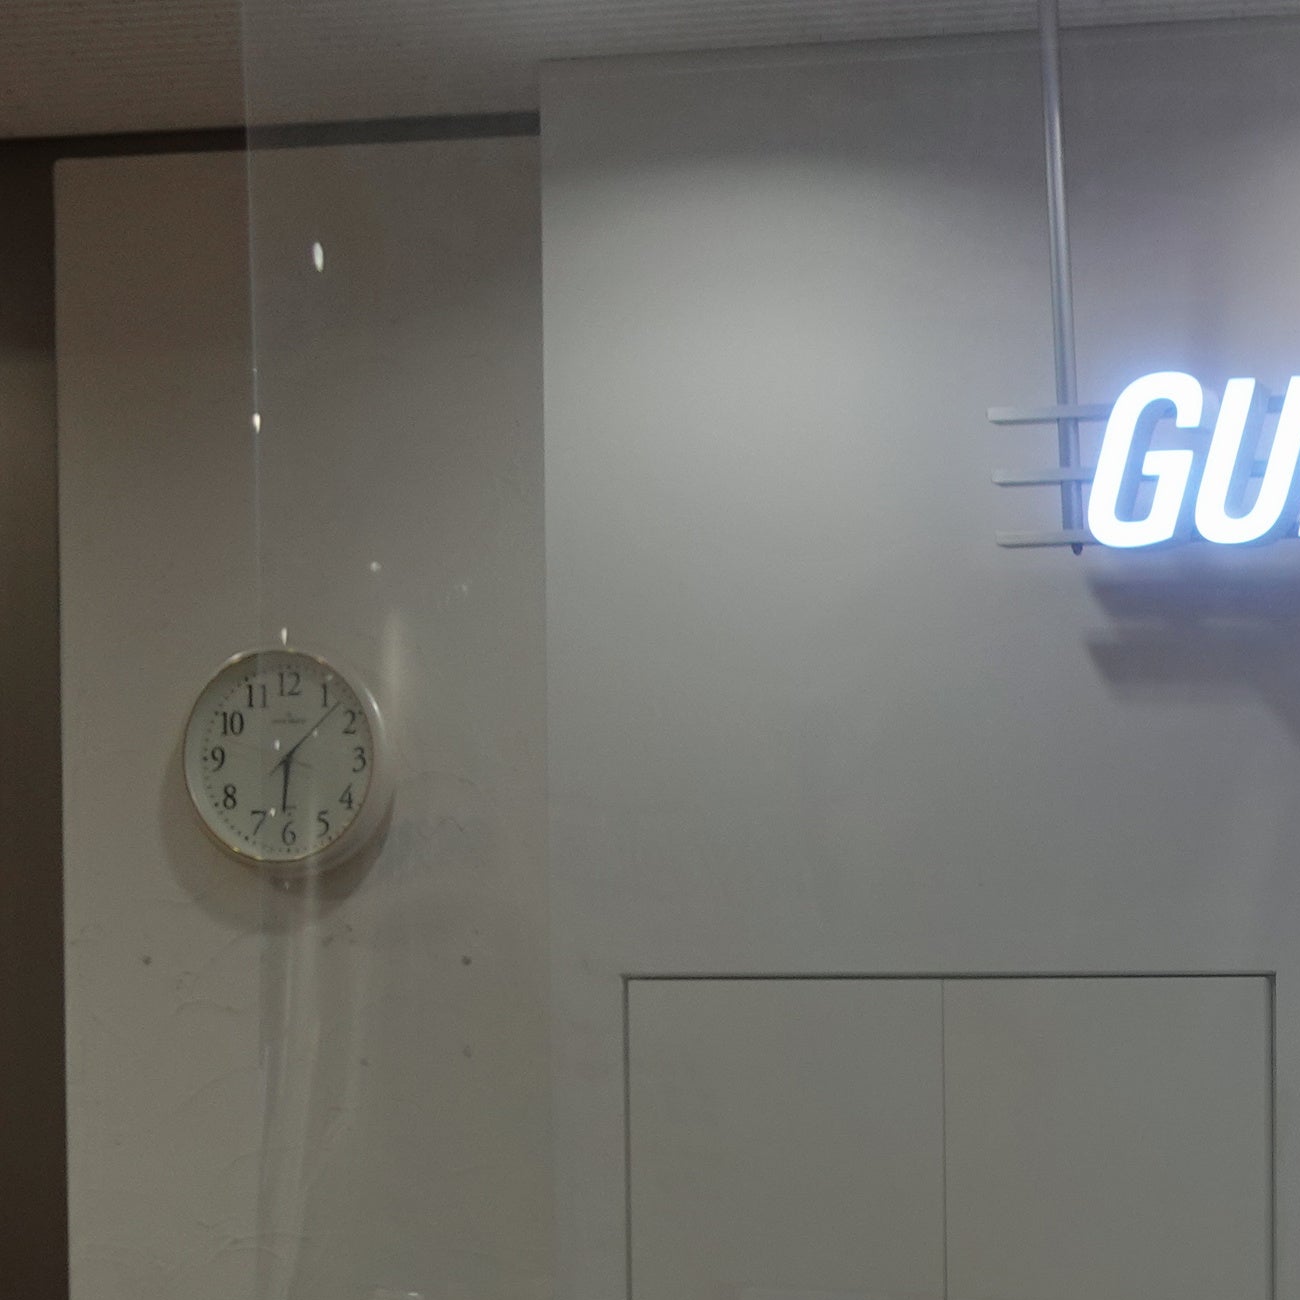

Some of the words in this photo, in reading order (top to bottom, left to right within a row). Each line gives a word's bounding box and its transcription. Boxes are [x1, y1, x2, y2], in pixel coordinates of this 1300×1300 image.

[246, 683, 267, 708] 11
[278, 671, 301, 697] 12
[320, 683, 329, 708] 1
[221, 710, 245, 737] 10
[341, 709, 356, 735] 2
[210, 746, 226, 773] 9
[352, 747, 366, 773] 3
[222, 784, 238, 811] 8
[337, 783, 353, 809] 4
[250, 810, 267, 837] 7
[281, 821, 297, 846] 6
[316, 810, 330, 838] 5
